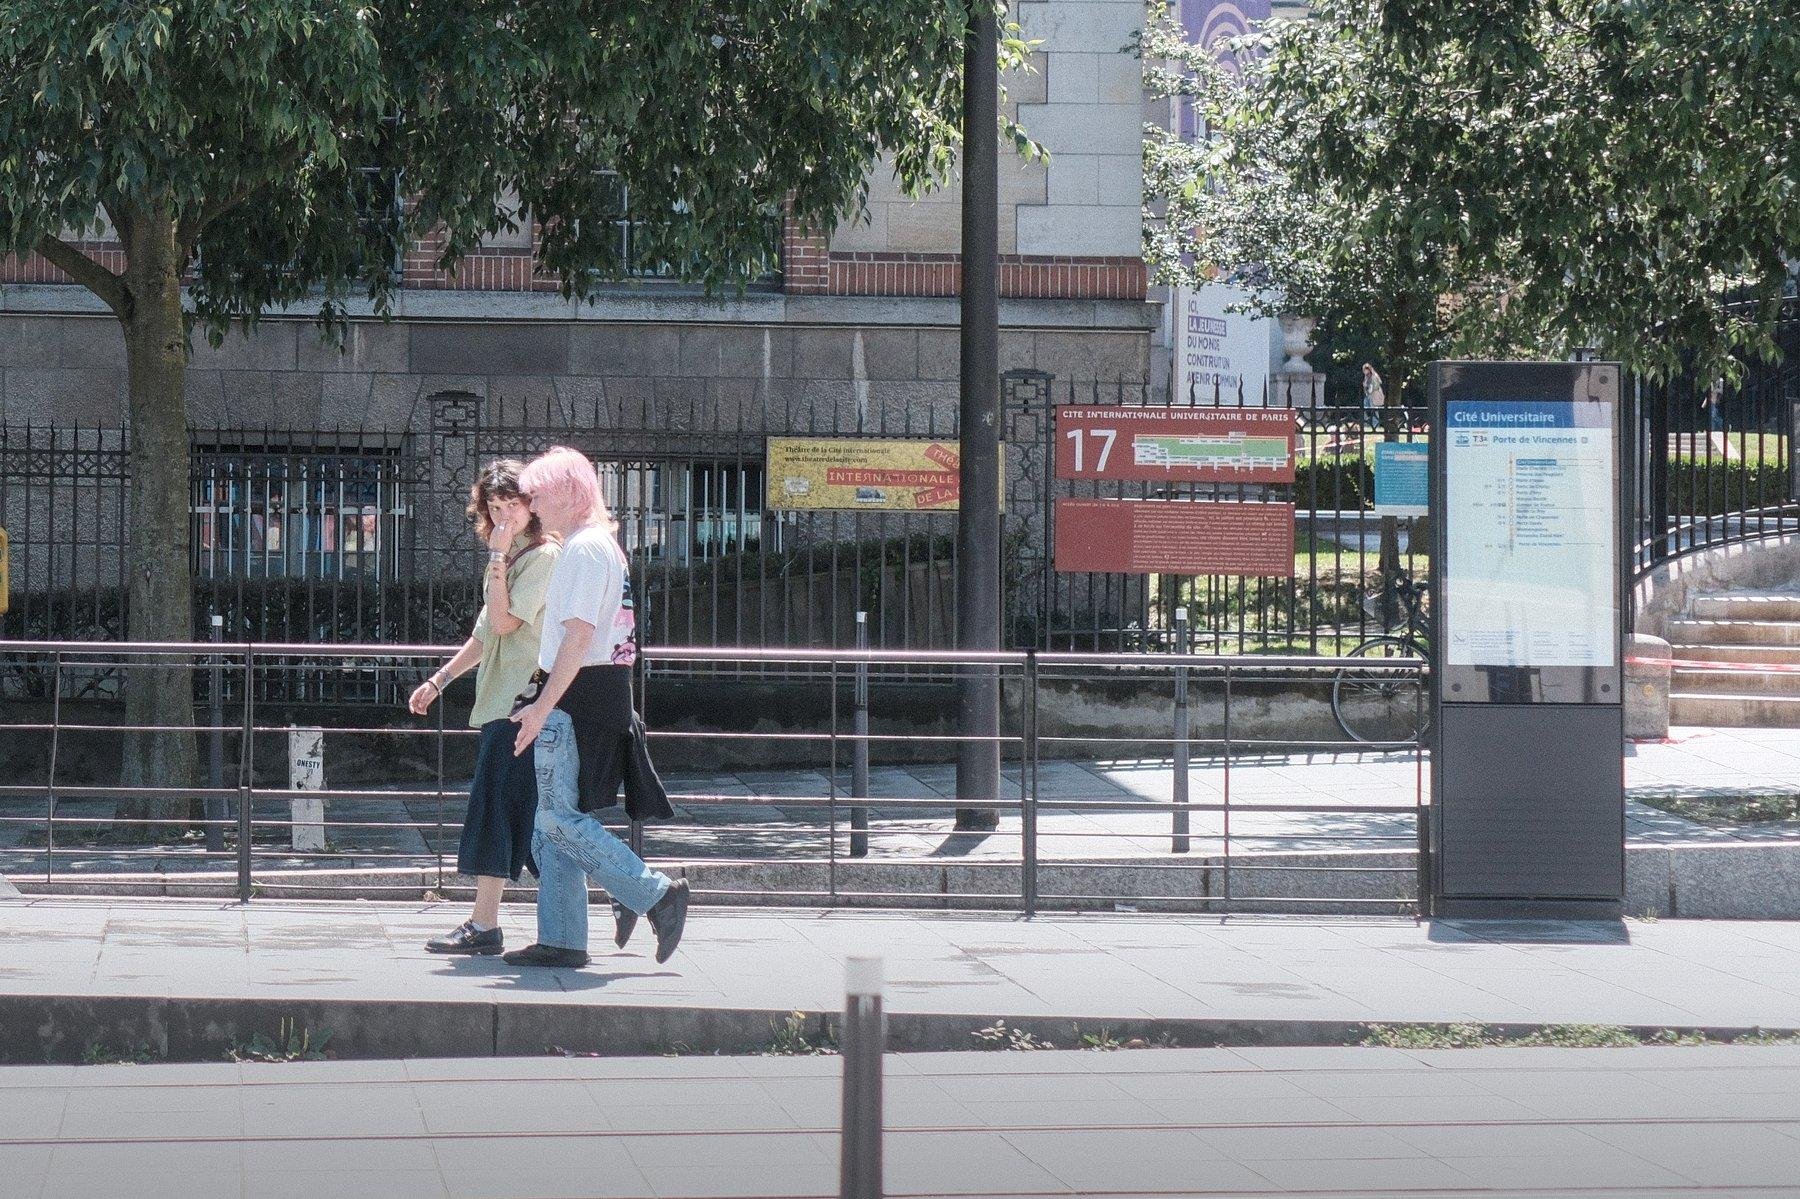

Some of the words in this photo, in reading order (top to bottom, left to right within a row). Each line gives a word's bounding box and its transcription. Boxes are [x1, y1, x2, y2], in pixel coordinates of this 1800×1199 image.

[1188, 316, 1198, 332] LA
[1198, 317, 1226, 336] JEUNESSE
[1187, 335, 1197, 348] DU
[1086, 410, 1167, 420] INTERNATIONALE
[1170, 412, 1242, 421] UNIVERSITAIRE
[1246, 413, 1258, 421] DE
[1261, 413, 1289, 422] PARIS
[1454, 411, 1478, 422] Cité
[1481, 411, 1555, 422] Universitaire
[1492, 435, 1516, 444] Porte
[1519, 435, 1531, 444] de
[1533, 435, 1578, 444] Vincennes
[1066, 428, 1118, 472] 17
[829, 472, 954, 484] INTERNATIONALE
[917, 492, 933, 504] DE
[936, 488, 953, 500] LA
